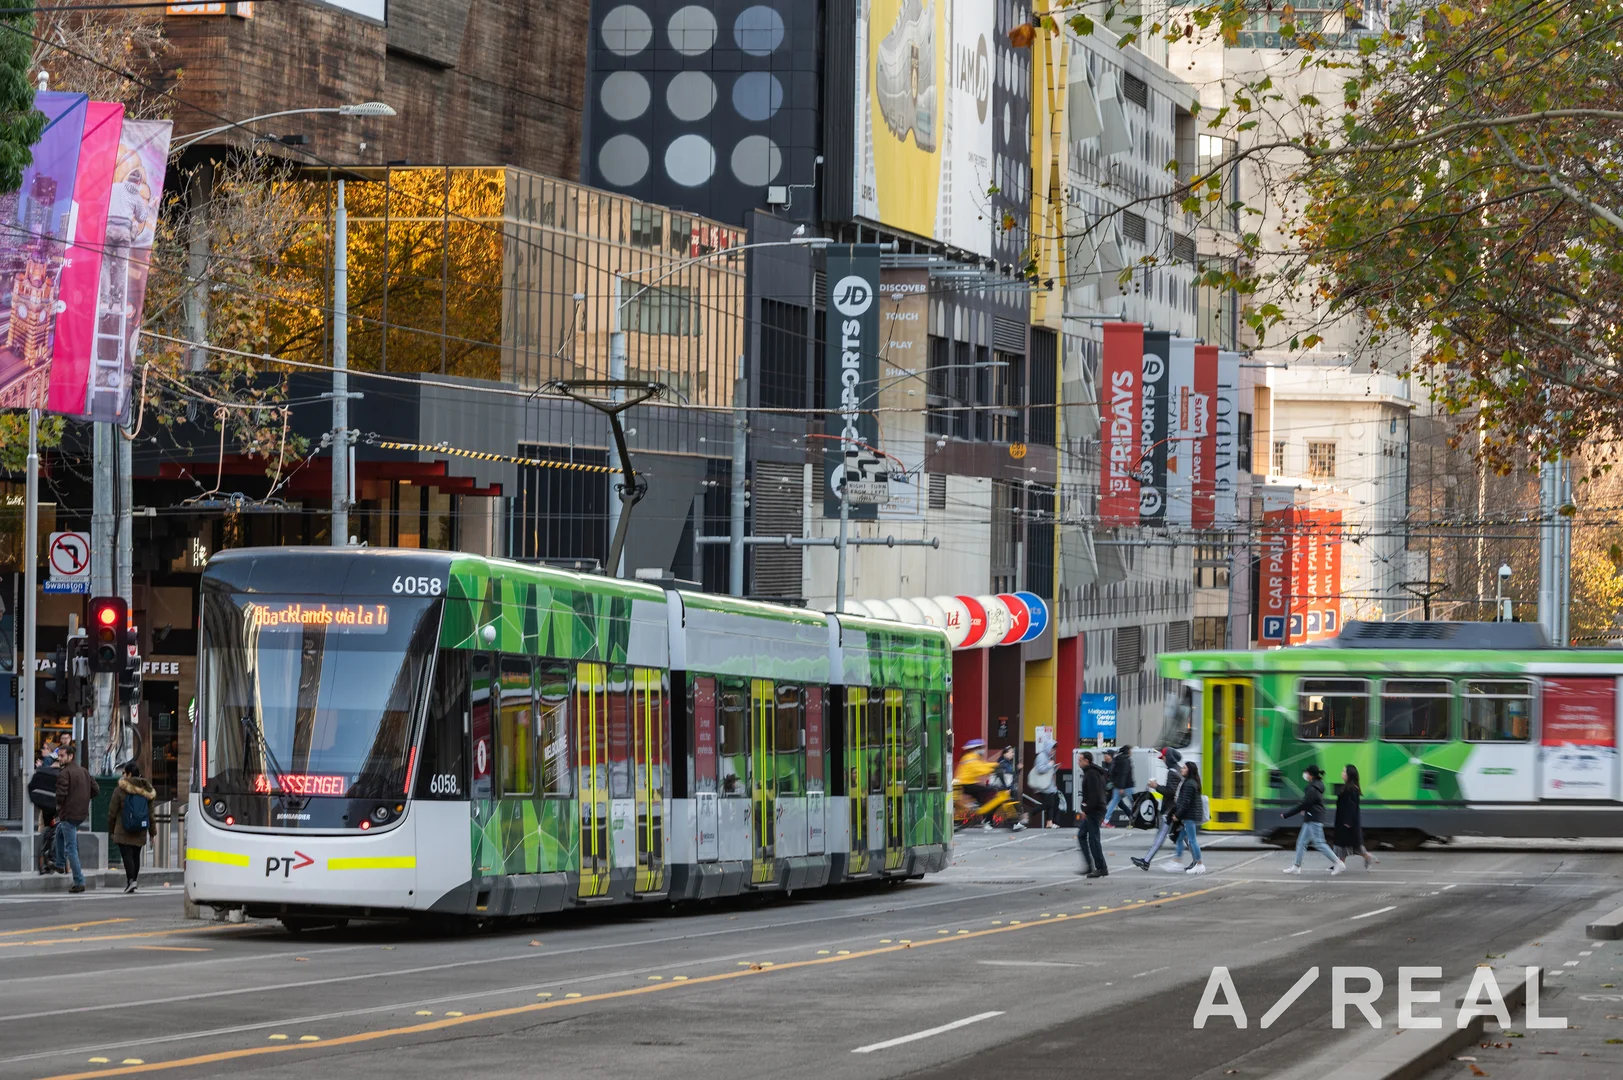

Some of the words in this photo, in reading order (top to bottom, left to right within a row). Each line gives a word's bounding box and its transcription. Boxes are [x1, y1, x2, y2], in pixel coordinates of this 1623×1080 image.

[838, 286, 868, 305] JD
[880, 284, 926, 292] DISCOVER
[885, 312, 919, 320] TOUCH
[841, 319, 860, 421] SPORTS
[885, 368, 917, 376] SHARE
[1109, 370, 1134, 478] FRIDAYS
[1141, 384, 1156, 458] SPORTS
[1109, 479, 1132, 492] TGI
[45, 581, 83, 590] Swanston
[391, 576, 442, 596] 6058
[1269, 576, 1283, 609] CAR
[335, 609, 355, 625] via
[357, 605, 374, 625] La
[1269, 620, 1281, 635] P
[141, 661, 180, 674] FFEE
[430, 774, 457, 794] 6058
